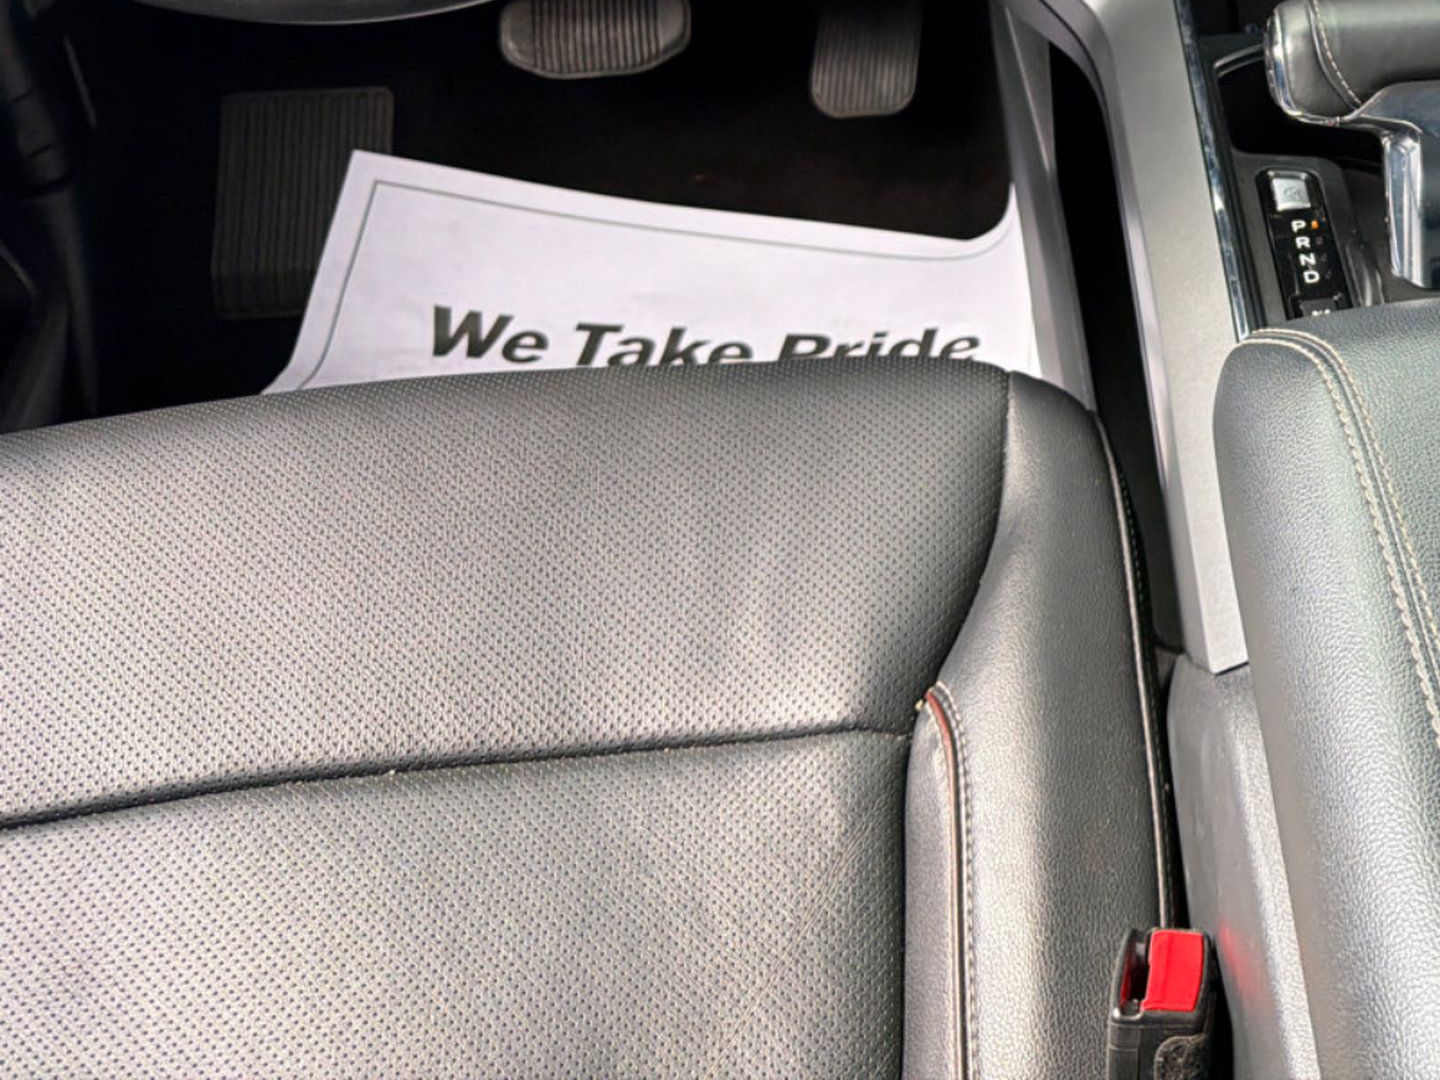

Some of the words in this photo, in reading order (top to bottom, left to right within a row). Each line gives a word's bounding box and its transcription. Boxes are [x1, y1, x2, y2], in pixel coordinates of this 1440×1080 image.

[1291, 220, 1307, 233] P
[1295, 236, 1311, 249] R
[1299, 252, 1316, 266] N
[1303, 270, 1321, 284] D
[432, 304, 549, 363] We
[573, 323, 753, 367] Take
[778, 327, 980, 362] Pride
